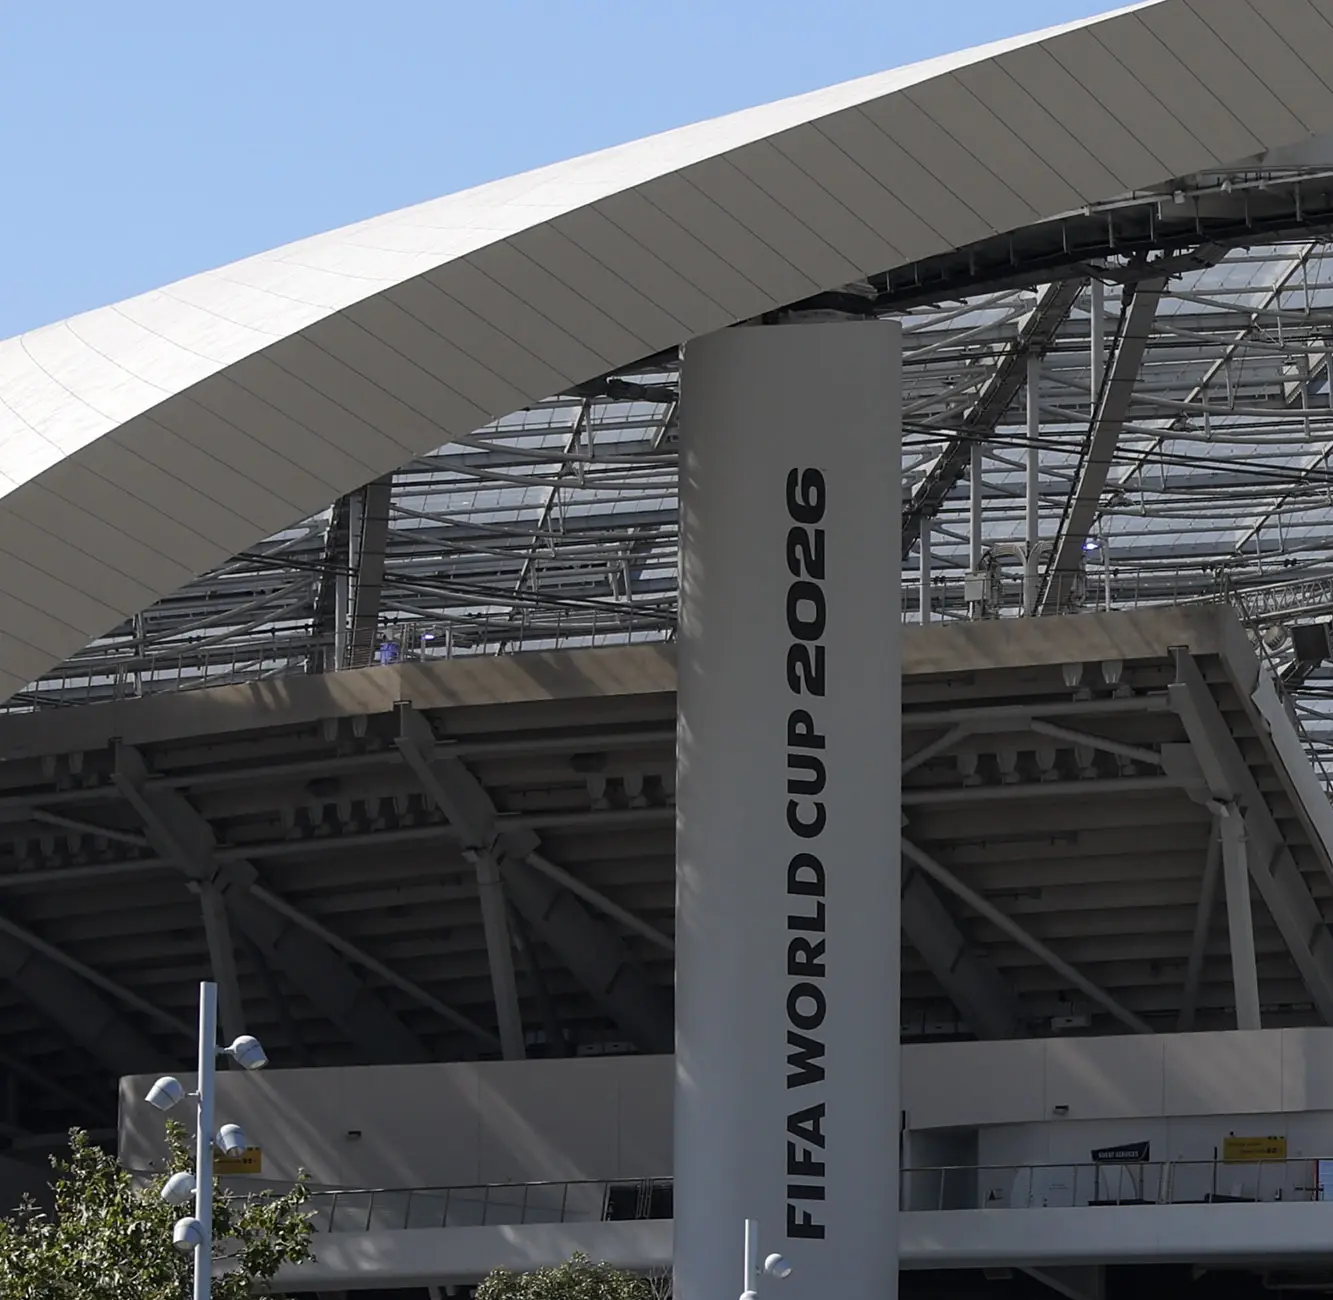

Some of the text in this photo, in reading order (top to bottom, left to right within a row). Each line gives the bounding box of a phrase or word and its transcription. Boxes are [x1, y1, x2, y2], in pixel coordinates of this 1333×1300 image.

[785, 467, 827, 1240] FIFA WORLD CUP 2026
